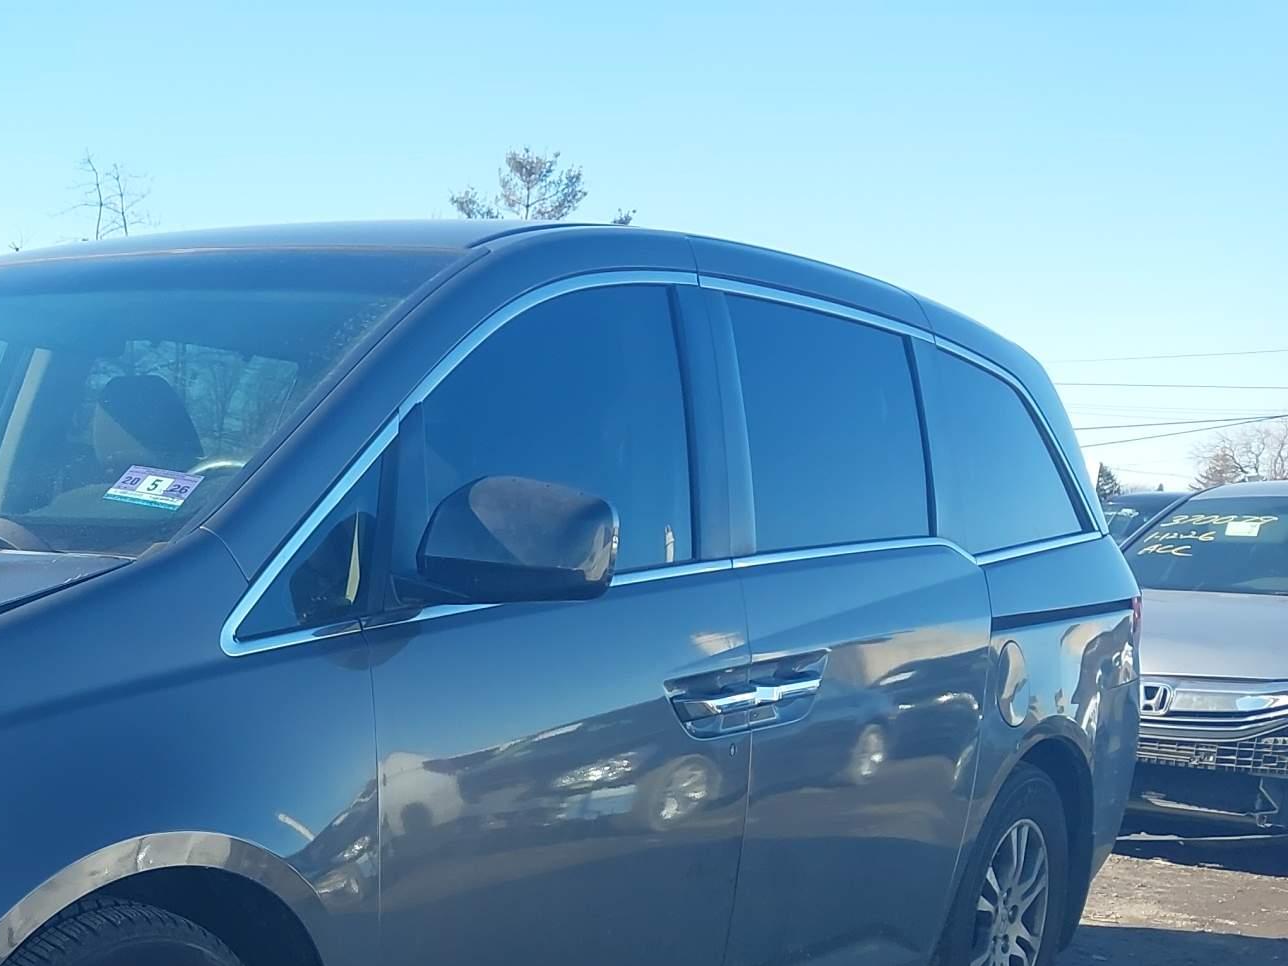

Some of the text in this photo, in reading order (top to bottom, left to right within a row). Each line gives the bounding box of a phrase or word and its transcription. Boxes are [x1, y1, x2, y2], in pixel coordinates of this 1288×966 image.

[121, 476, 191, 494] 20 5 26
